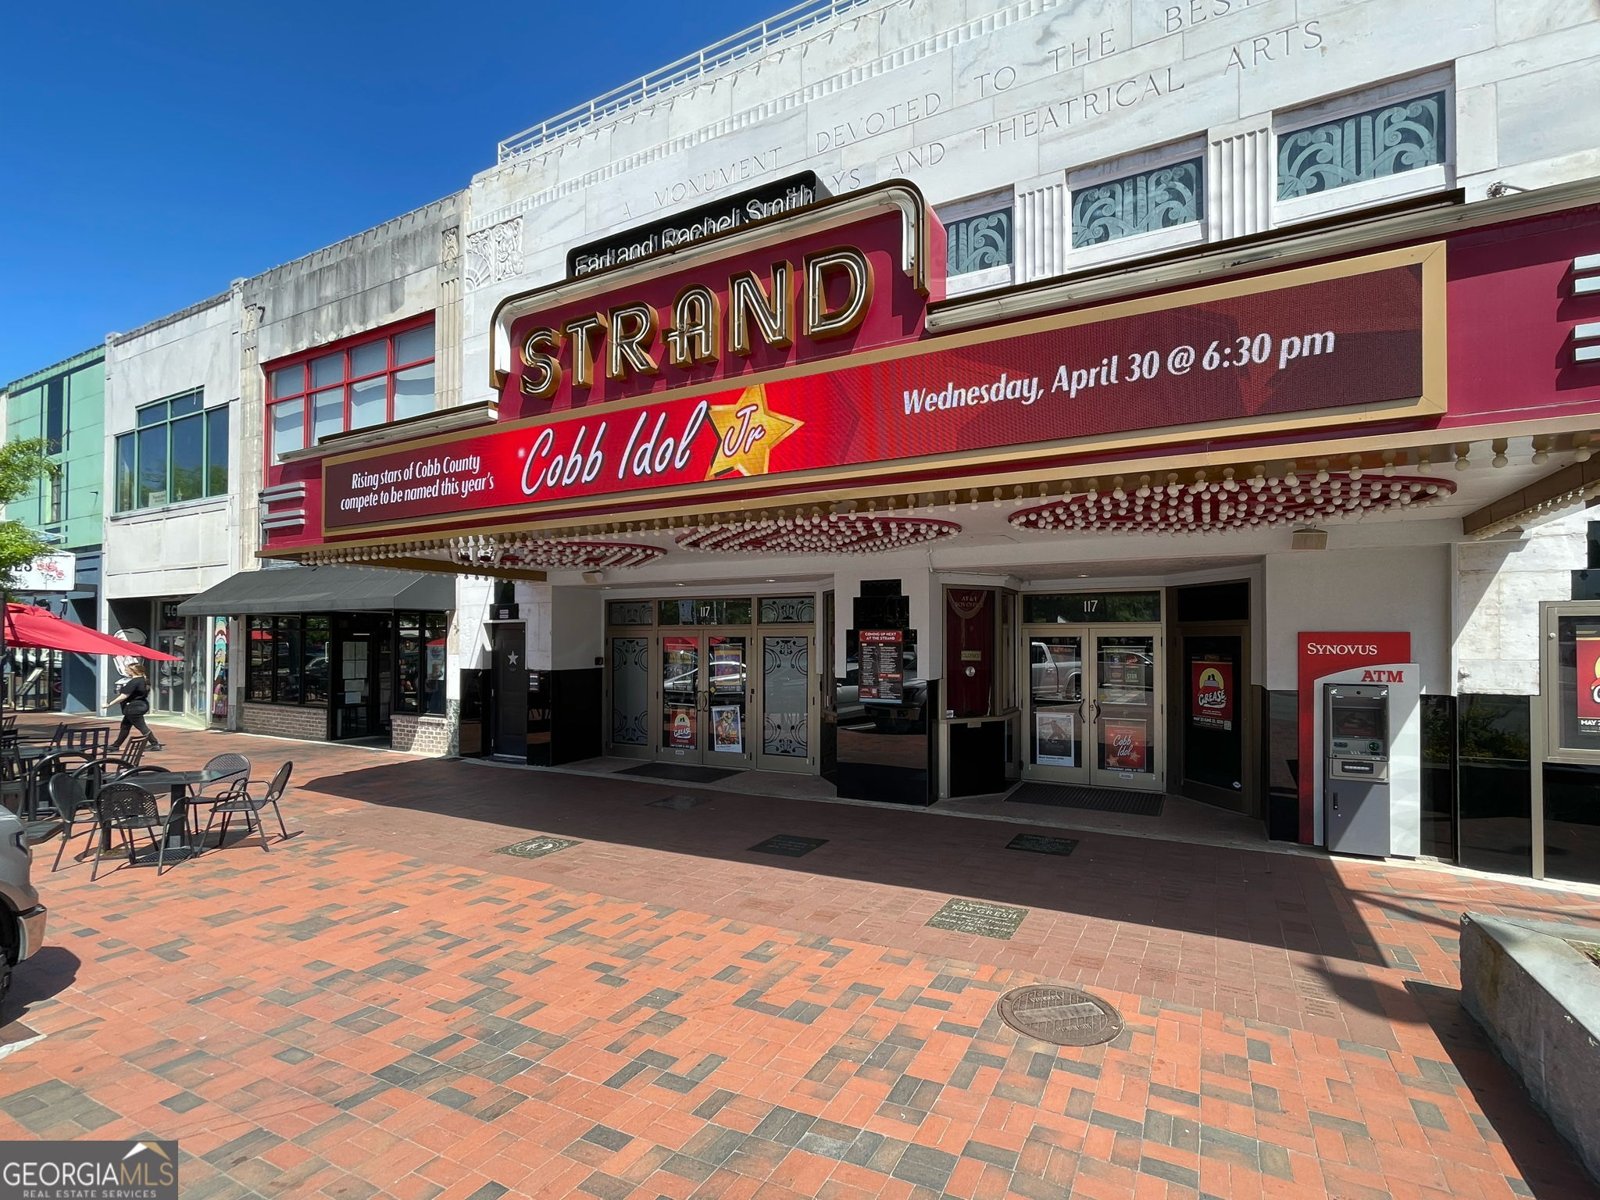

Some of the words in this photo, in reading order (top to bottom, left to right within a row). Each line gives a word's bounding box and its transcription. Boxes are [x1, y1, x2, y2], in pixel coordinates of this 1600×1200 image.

[653, 146, 783, 209] MONUMENT
[816, 92, 941, 153] DEVOTED
[973, 66, 1017, 99] TO
[1048, 28, 1117, 72] THE
[1165, 0, 1250, 33] BES
[888, 142, 946, 178] AND
[976, 68, 1185, 150] THEATRICAL
[1223, 20, 1323, 75] ARTS
[617, 232, 655, 262] and
[746, 183, 815, 221] Smith
[520, 245, 875, 399] STRAND
[902, 373, 1046, 415] Wednesday,
[1050, 354, 1119, 398] April
[1124, 350, 1160, 382] 30
[1166, 345, 1196, 376] @
[1202, 332, 1272, 371] 6:30
[1278, 329, 1336, 369] pm
[520, 424, 602, 496] Cobb
[617, 400, 710, 480] Idol
[722, 404, 766, 457] Jr
[340, 492, 378, 512] compete
[380, 491, 389, 504] to
[390, 487, 402, 503] be
[404, 479, 440, 502] named
[441, 477, 459, 496] this
[461, 472, 495, 498] year's
[351, 471, 379, 490] Rising
[380, 469, 402, 485] stars
[403, 461, 415, 480] of
[415, 458, 441, 479] Cobb
[443, 454, 481, 475] County
[1083, 600, 1098, 613] 117
[1307, 642, 1378, 656] SYNOVUS
[1360, 670, 1404, 683] ATM
[1113, 734, 1132, 747] Cobb
[1117, 744, 1134, 757] Idol
